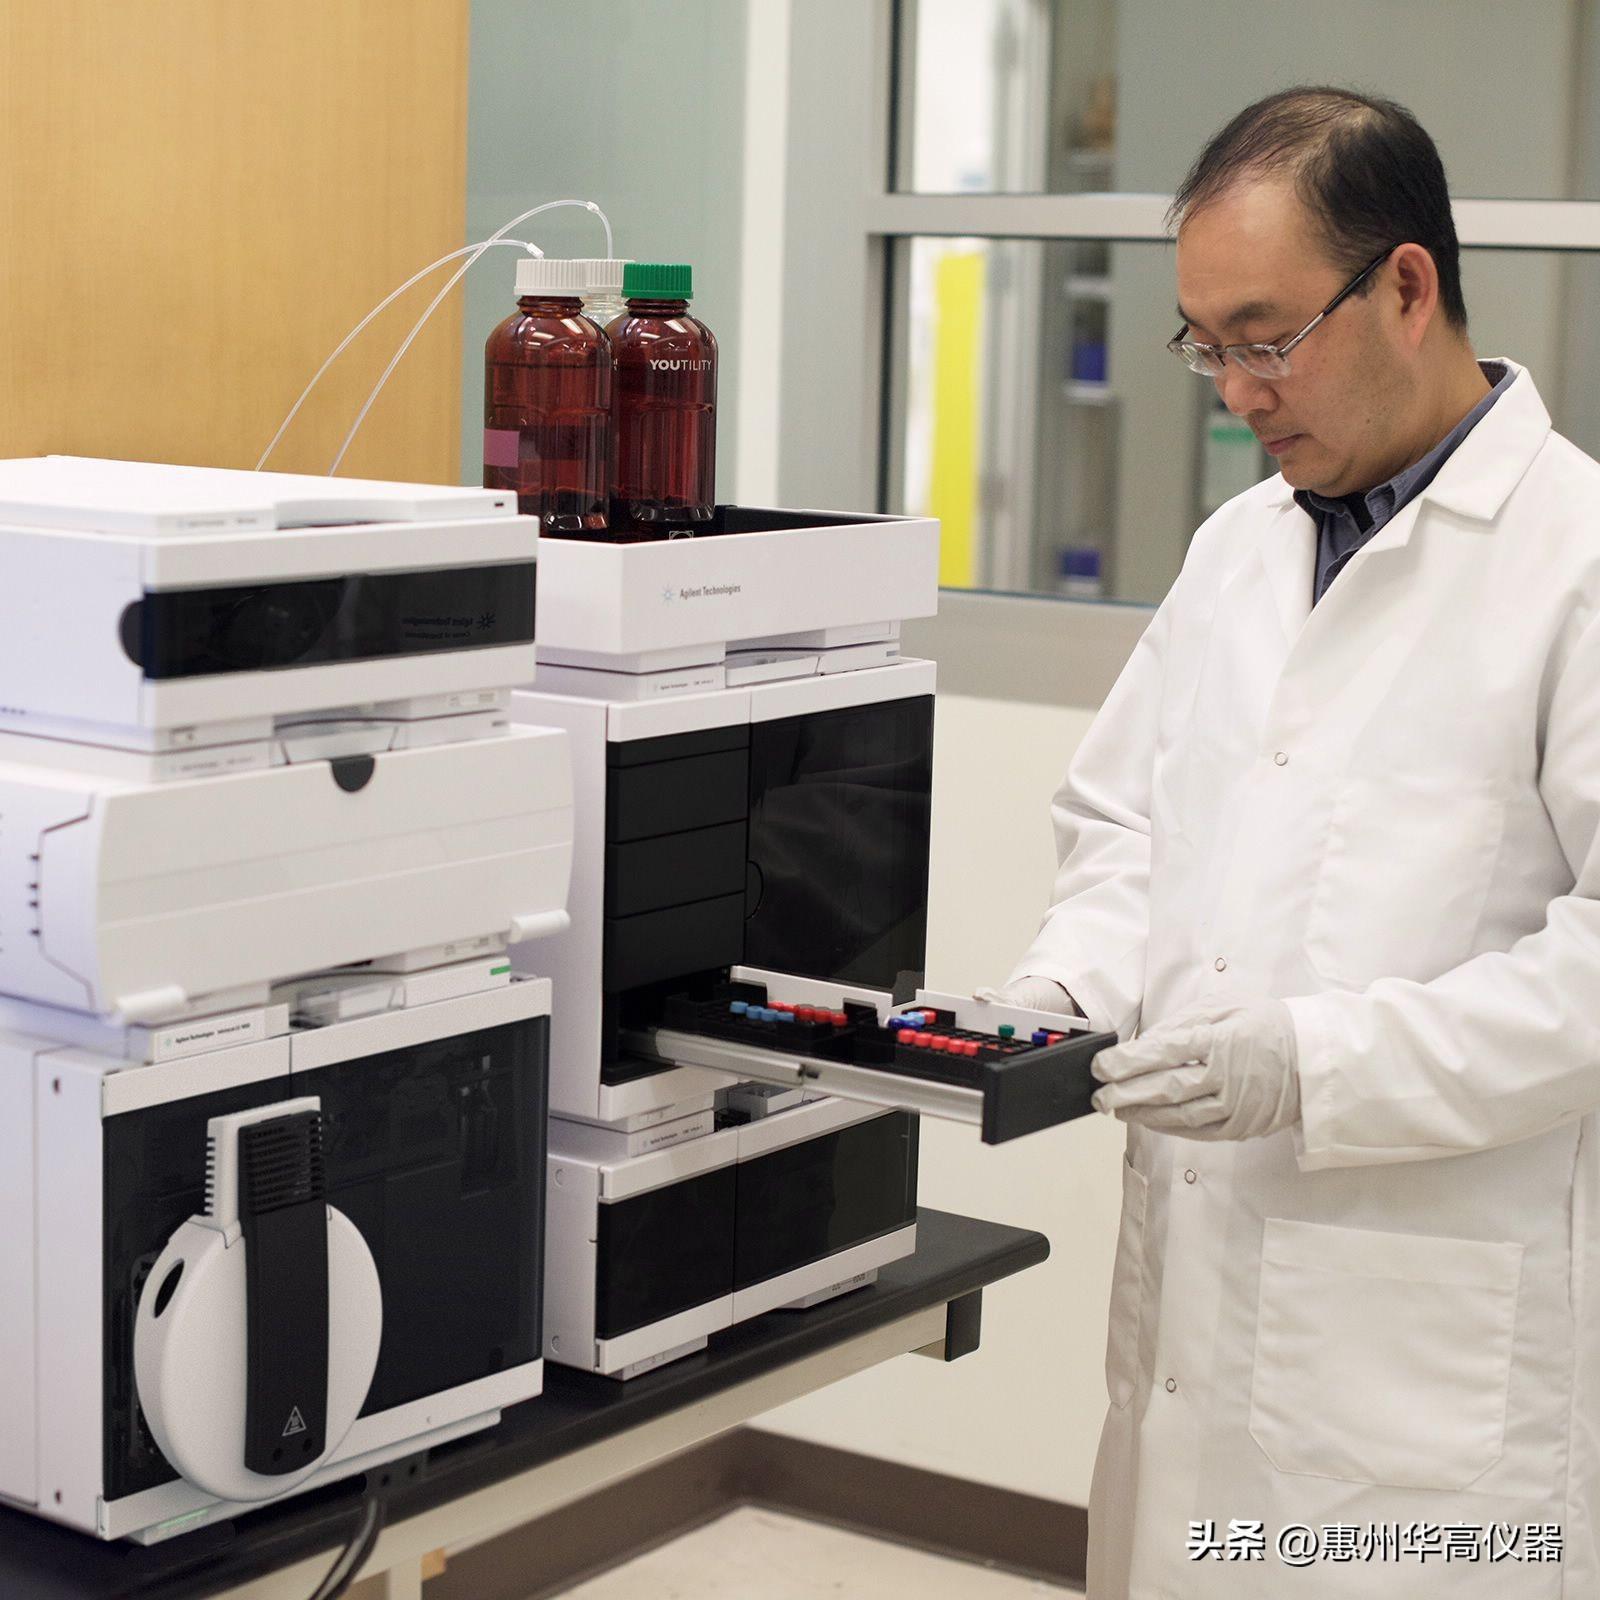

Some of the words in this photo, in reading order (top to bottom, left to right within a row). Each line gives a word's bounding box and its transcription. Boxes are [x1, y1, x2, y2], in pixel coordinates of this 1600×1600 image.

[649, 359, 712, 371] YOUTILITY
[680, 588, 702, 600] Agilent
[703, 585, 741, 596] Technologies
